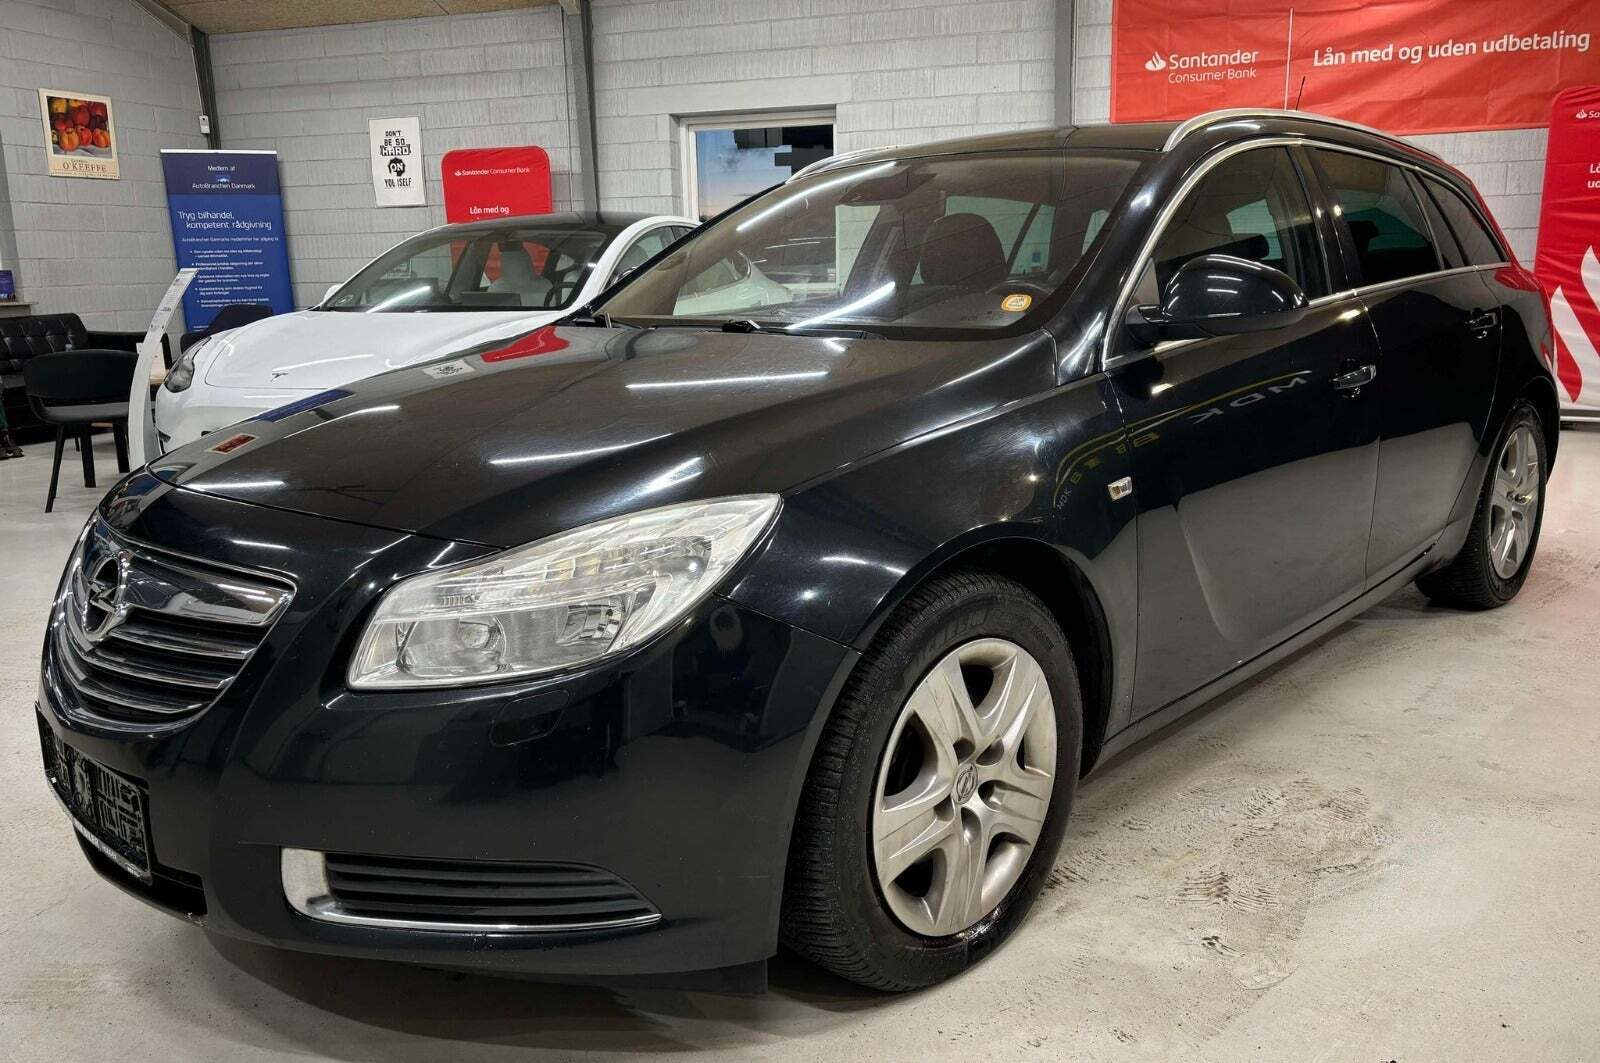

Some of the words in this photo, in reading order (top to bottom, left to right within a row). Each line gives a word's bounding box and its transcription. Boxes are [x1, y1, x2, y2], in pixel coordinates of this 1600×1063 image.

[1313, 47, 1345, 66] Lån
[1351, 44, 1392, 63] med
[1398, 45, 1423, 64] og
[1428, 40, 1476, 58] uden
[1482, 30, 1590, 53] udbetaling
[1169, 50, 1259, 69] Santander
[1168, 70, 1225, 83] Consumer
[1228, 68, 1256, 79] Bank
[382, 146, 410, 156] HARD
[390, 163, 404, 172] ON
[469, 206, 482, 215] Lån
[500, 207, 510, 215] og
[177, 211, 196, 221] Tryg
[197, 211, 234, 220] bilhandel,
[186, 221, 229, 229] kompetent
[232, 220, 272, 229] rådgivning
